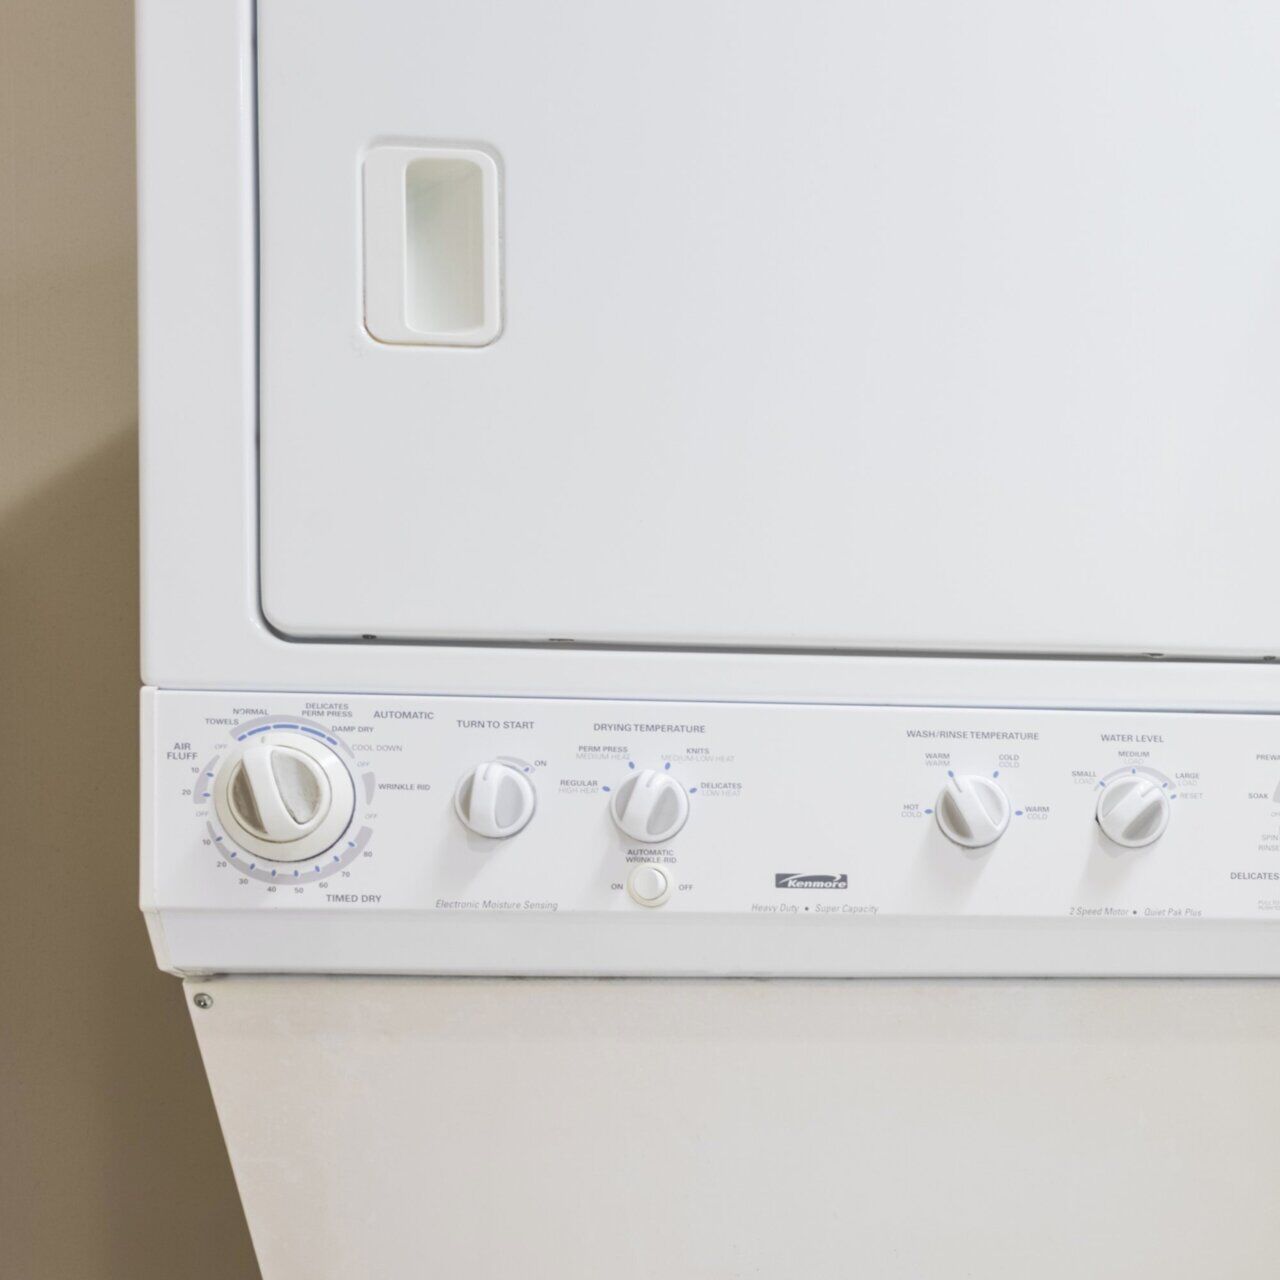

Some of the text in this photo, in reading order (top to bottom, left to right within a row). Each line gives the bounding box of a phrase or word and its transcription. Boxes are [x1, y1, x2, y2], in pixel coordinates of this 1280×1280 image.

[233, 708, 270, 716] NORMAL
[373, 710, 434, 720] AUTOMATIC
[205, 718, 239, 726] TOWELS
[457, 720, 535, 729] TURN TO START
[331, 725, 356, 733] DAMP
[593, 723, 706, 733] DRYING TEMPERATURE
[906, 730, 1039, 741] WASH/RINSE TEMPERATURE
[1101, 734, 1164, 743] WATER LEVEL
[174, 742, 191, 750] AIR
[167, 752, 198, 760] FLUFF
[378, 783, 415, 791] WRINKLE
[701, 782, 742, 790] DELICATES
[627, 849, 674, 857] AUTOMATIC
[625, 856, 662, 864] WRINKLE
[1230, 872, 1280, 880] DELICATES
[788, 880, 847, 889] Kenmore
[326, 894, 382, 903] TIMED DRY
[435, 899, 559, 911] Electronic Moisture Sensing
[751, 904, 879, 914] Heavy Duty Super Capacity
